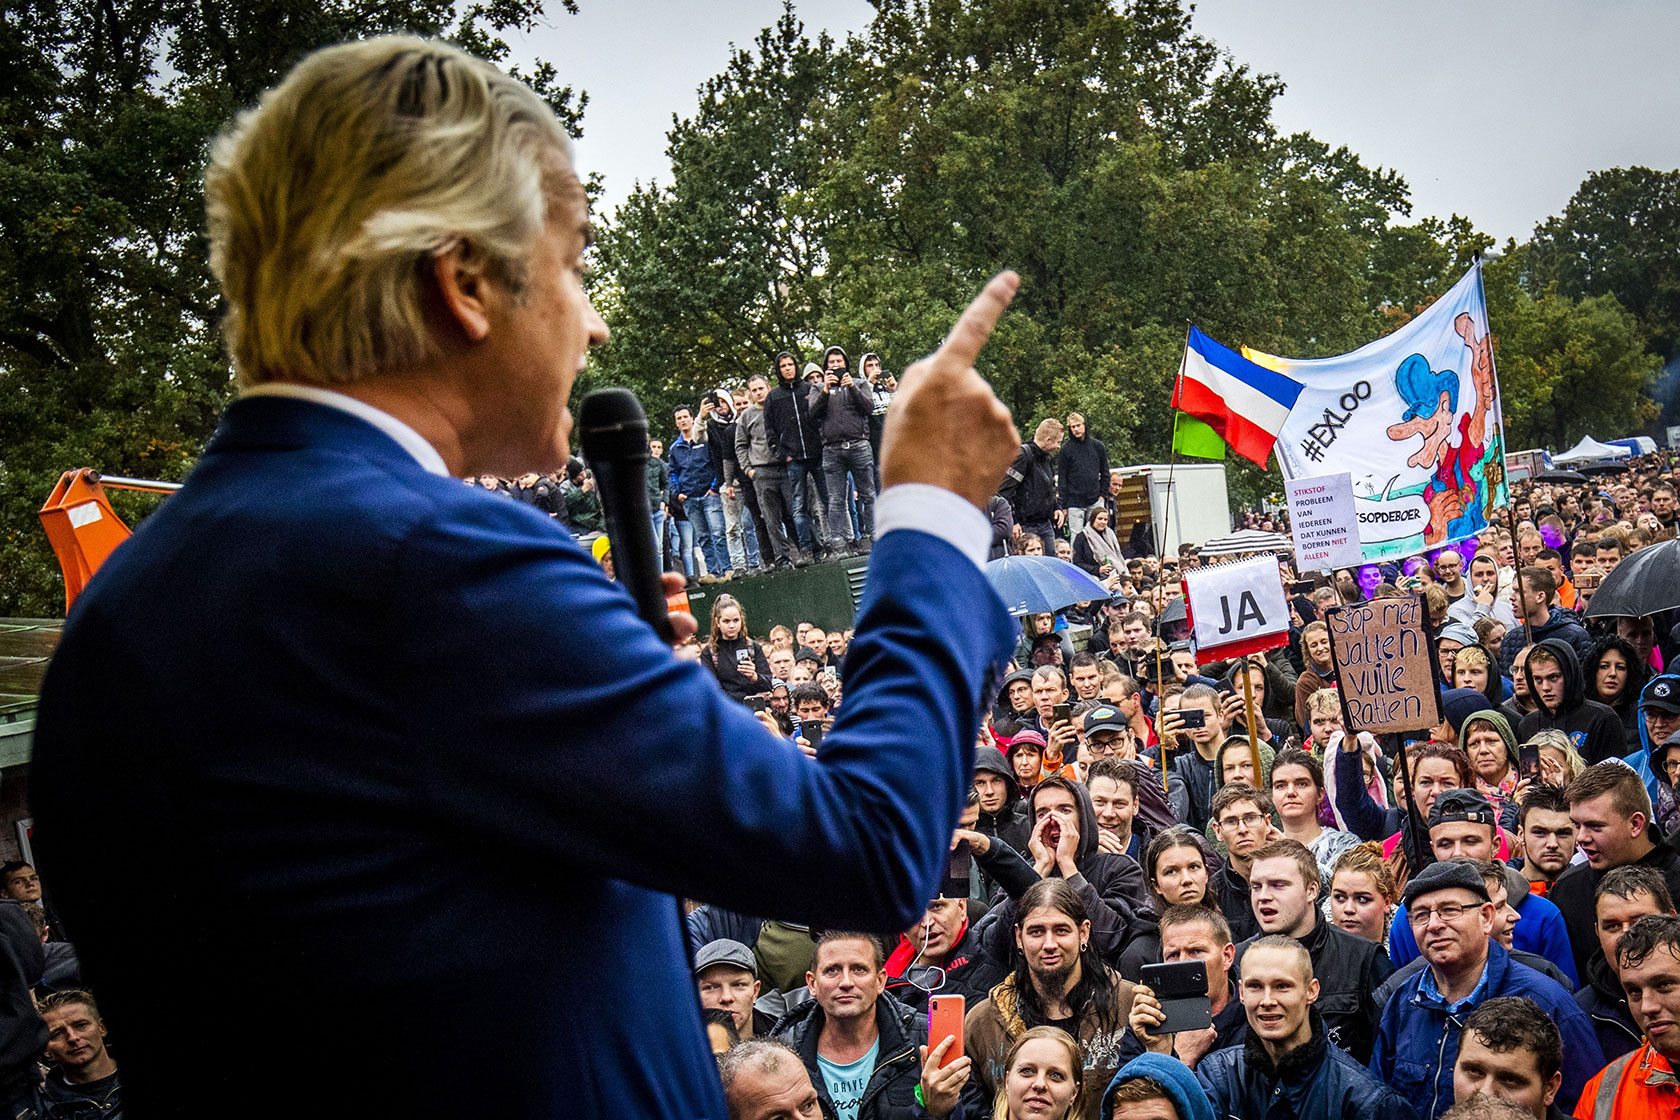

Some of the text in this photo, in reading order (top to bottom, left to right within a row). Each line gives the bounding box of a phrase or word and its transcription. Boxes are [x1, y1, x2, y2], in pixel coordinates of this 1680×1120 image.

[1300, 380, 1372, 463] #EXLOO
[1294, 486, 1326, 496] STIKSTOF
[1296, 496, 1333, 506] PROBLEEM
[1356, 508, 1421, 523] SOPDEBOER
[1299, 518, 1332, 528] IEDEREEN
[1316, 527, 1347, 537] KUNNEN
[1302, 541, 1330, 550] BOEREN
[1304, 552, 1329, 560] ALLEEN
[1218, 590, 1267, 635] JA
[1333, 598, 1419, 635] Stop met
[1346, 695, 1421, 727] Ratten
[834, 1078, 864, 1094] DRIVE
